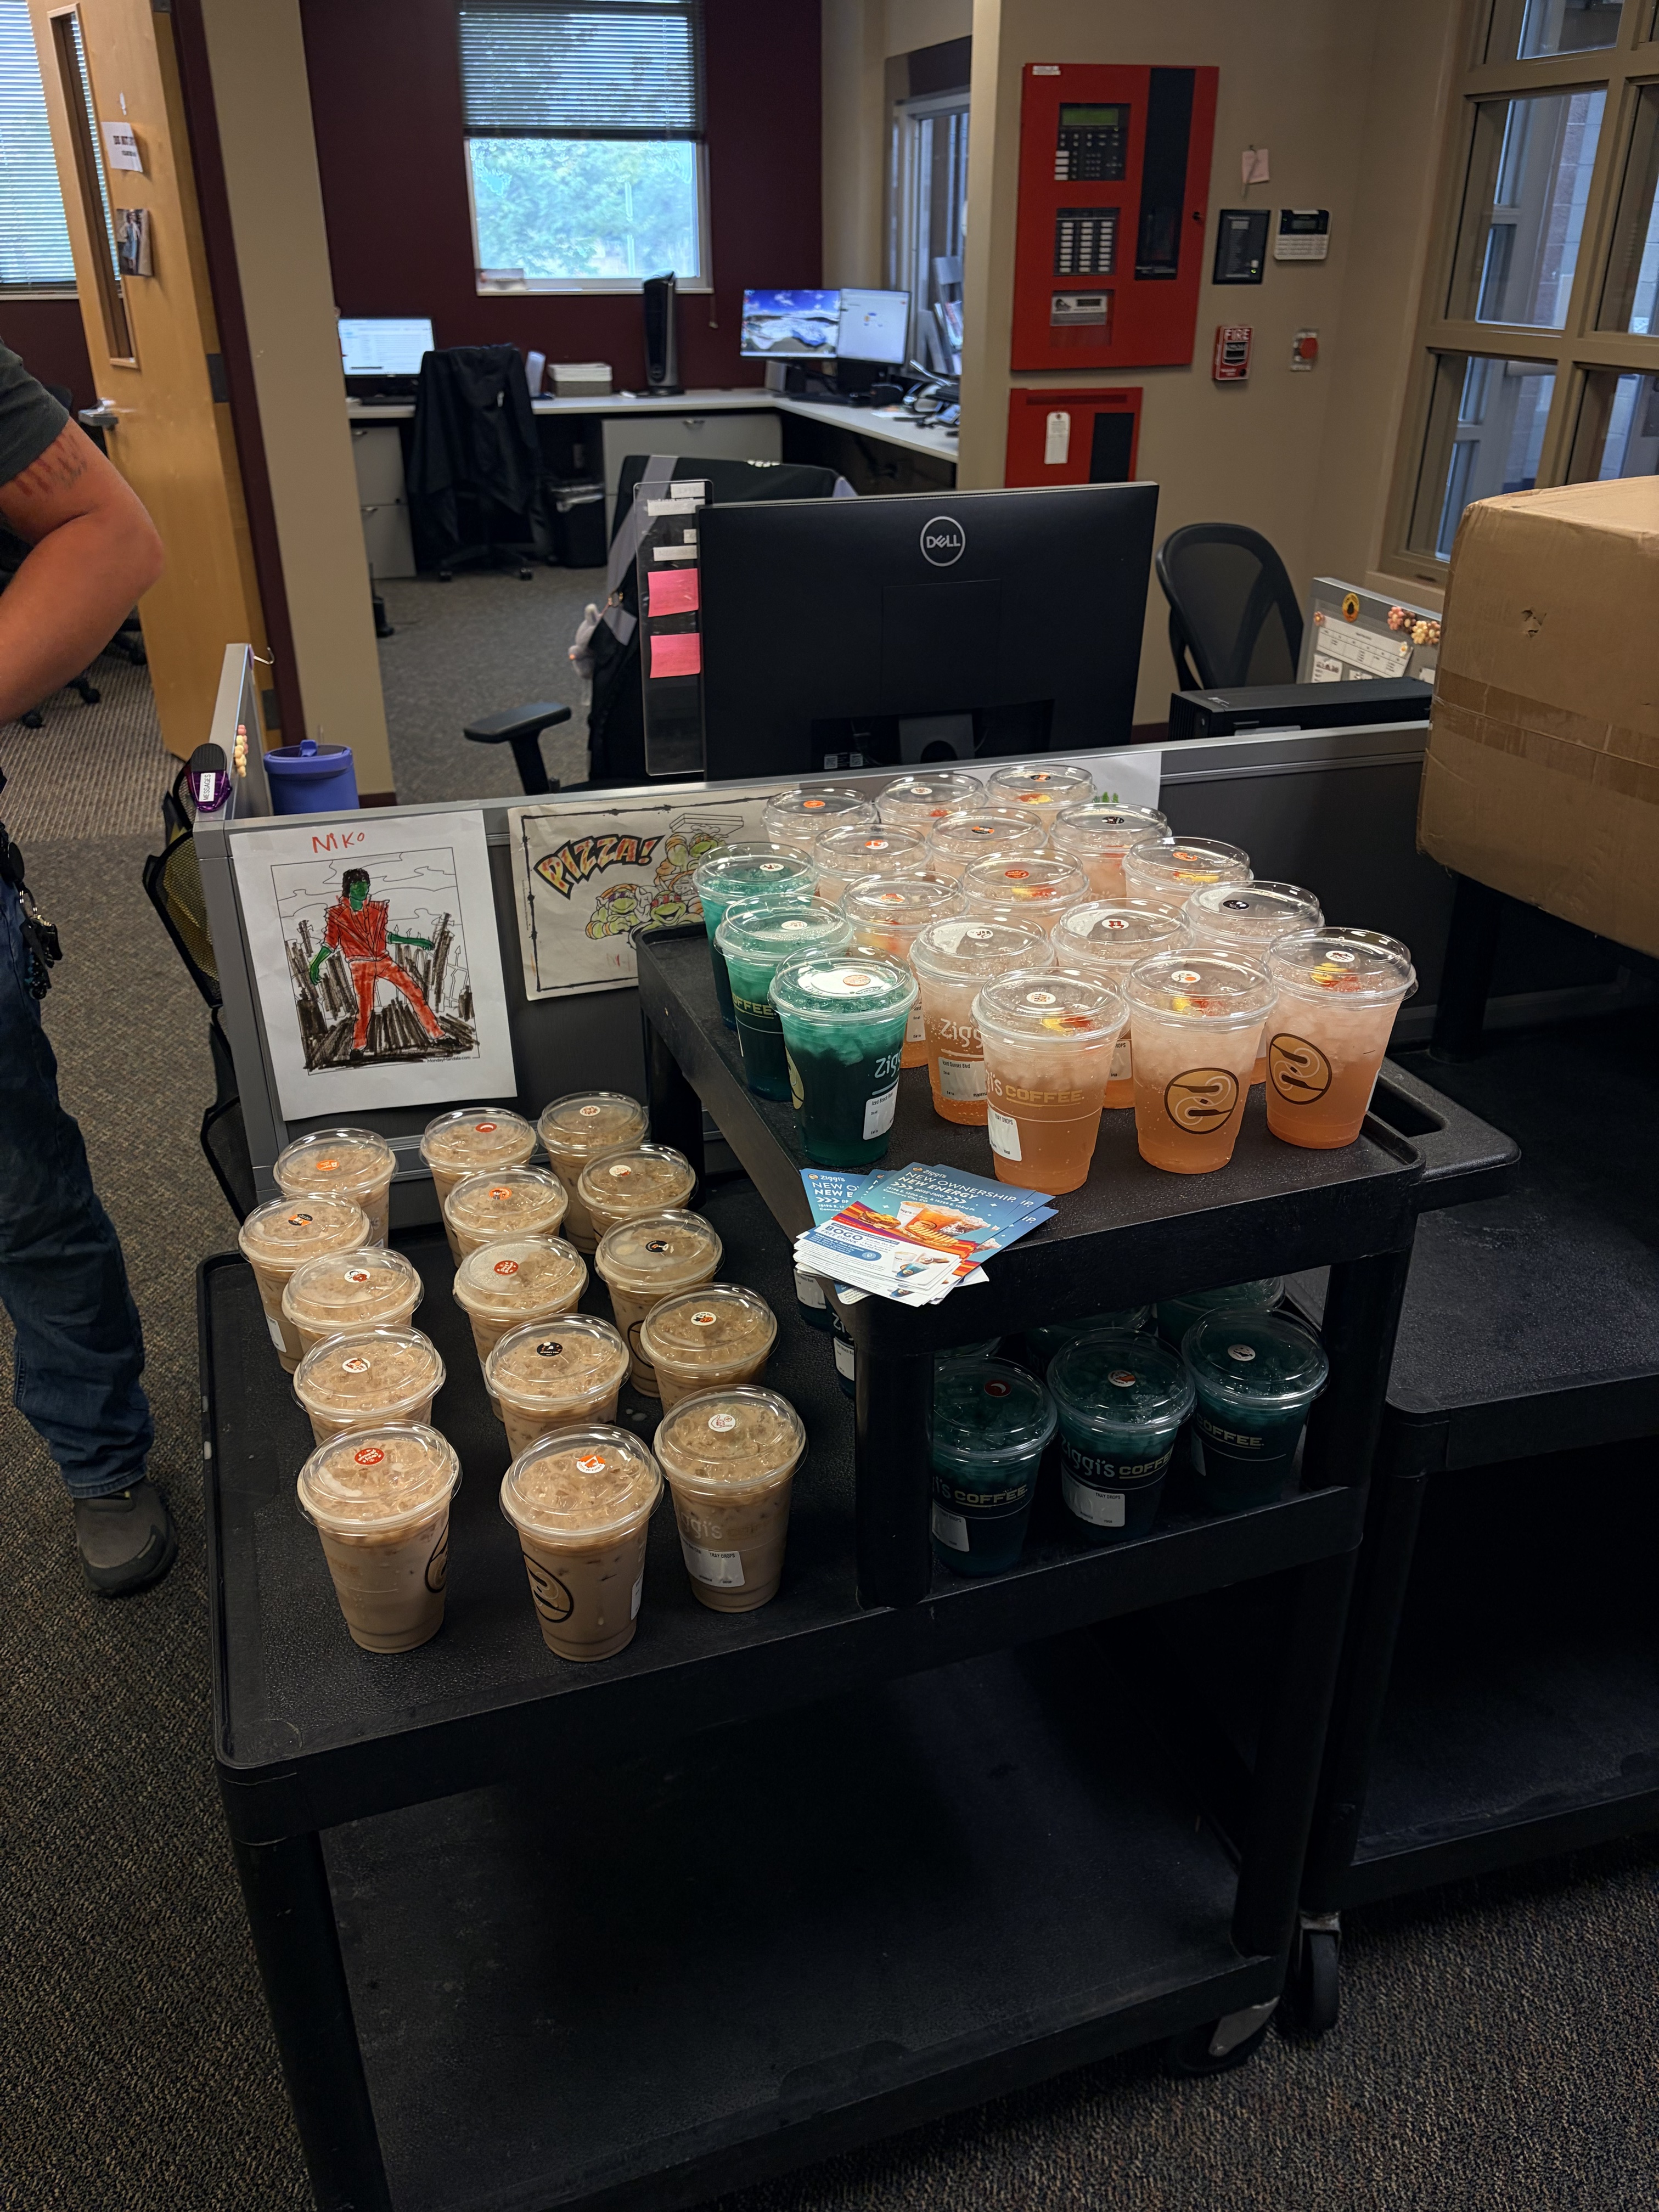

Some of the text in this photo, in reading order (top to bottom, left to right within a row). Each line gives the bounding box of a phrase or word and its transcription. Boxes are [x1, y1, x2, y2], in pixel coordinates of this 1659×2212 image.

[1225, 329, 1250, 340] FIRE
[926, 534, 961, 548] DELL
[203, 774, 211, 801] MESSAGES
[533, 834, 666, 900] PIZZA!
[732, 992, 774, 1016] OFFEE
[940, 1018, 982, 1049] Zigg
[1005, 1085, 1083, 1103] COFFEE
[812, 1181, 842, 1190] NEW
[898, 1177, 978, 1199] NEW ENERGY
[906, 1172, 1017, 1203] NEW OWNERSHIP,
[821, 1230, 858, 1245] FREE DRINK
[825, 1225, 863, 1241] BOGO
[954, 1484, 1028, 1504] COFFEE
